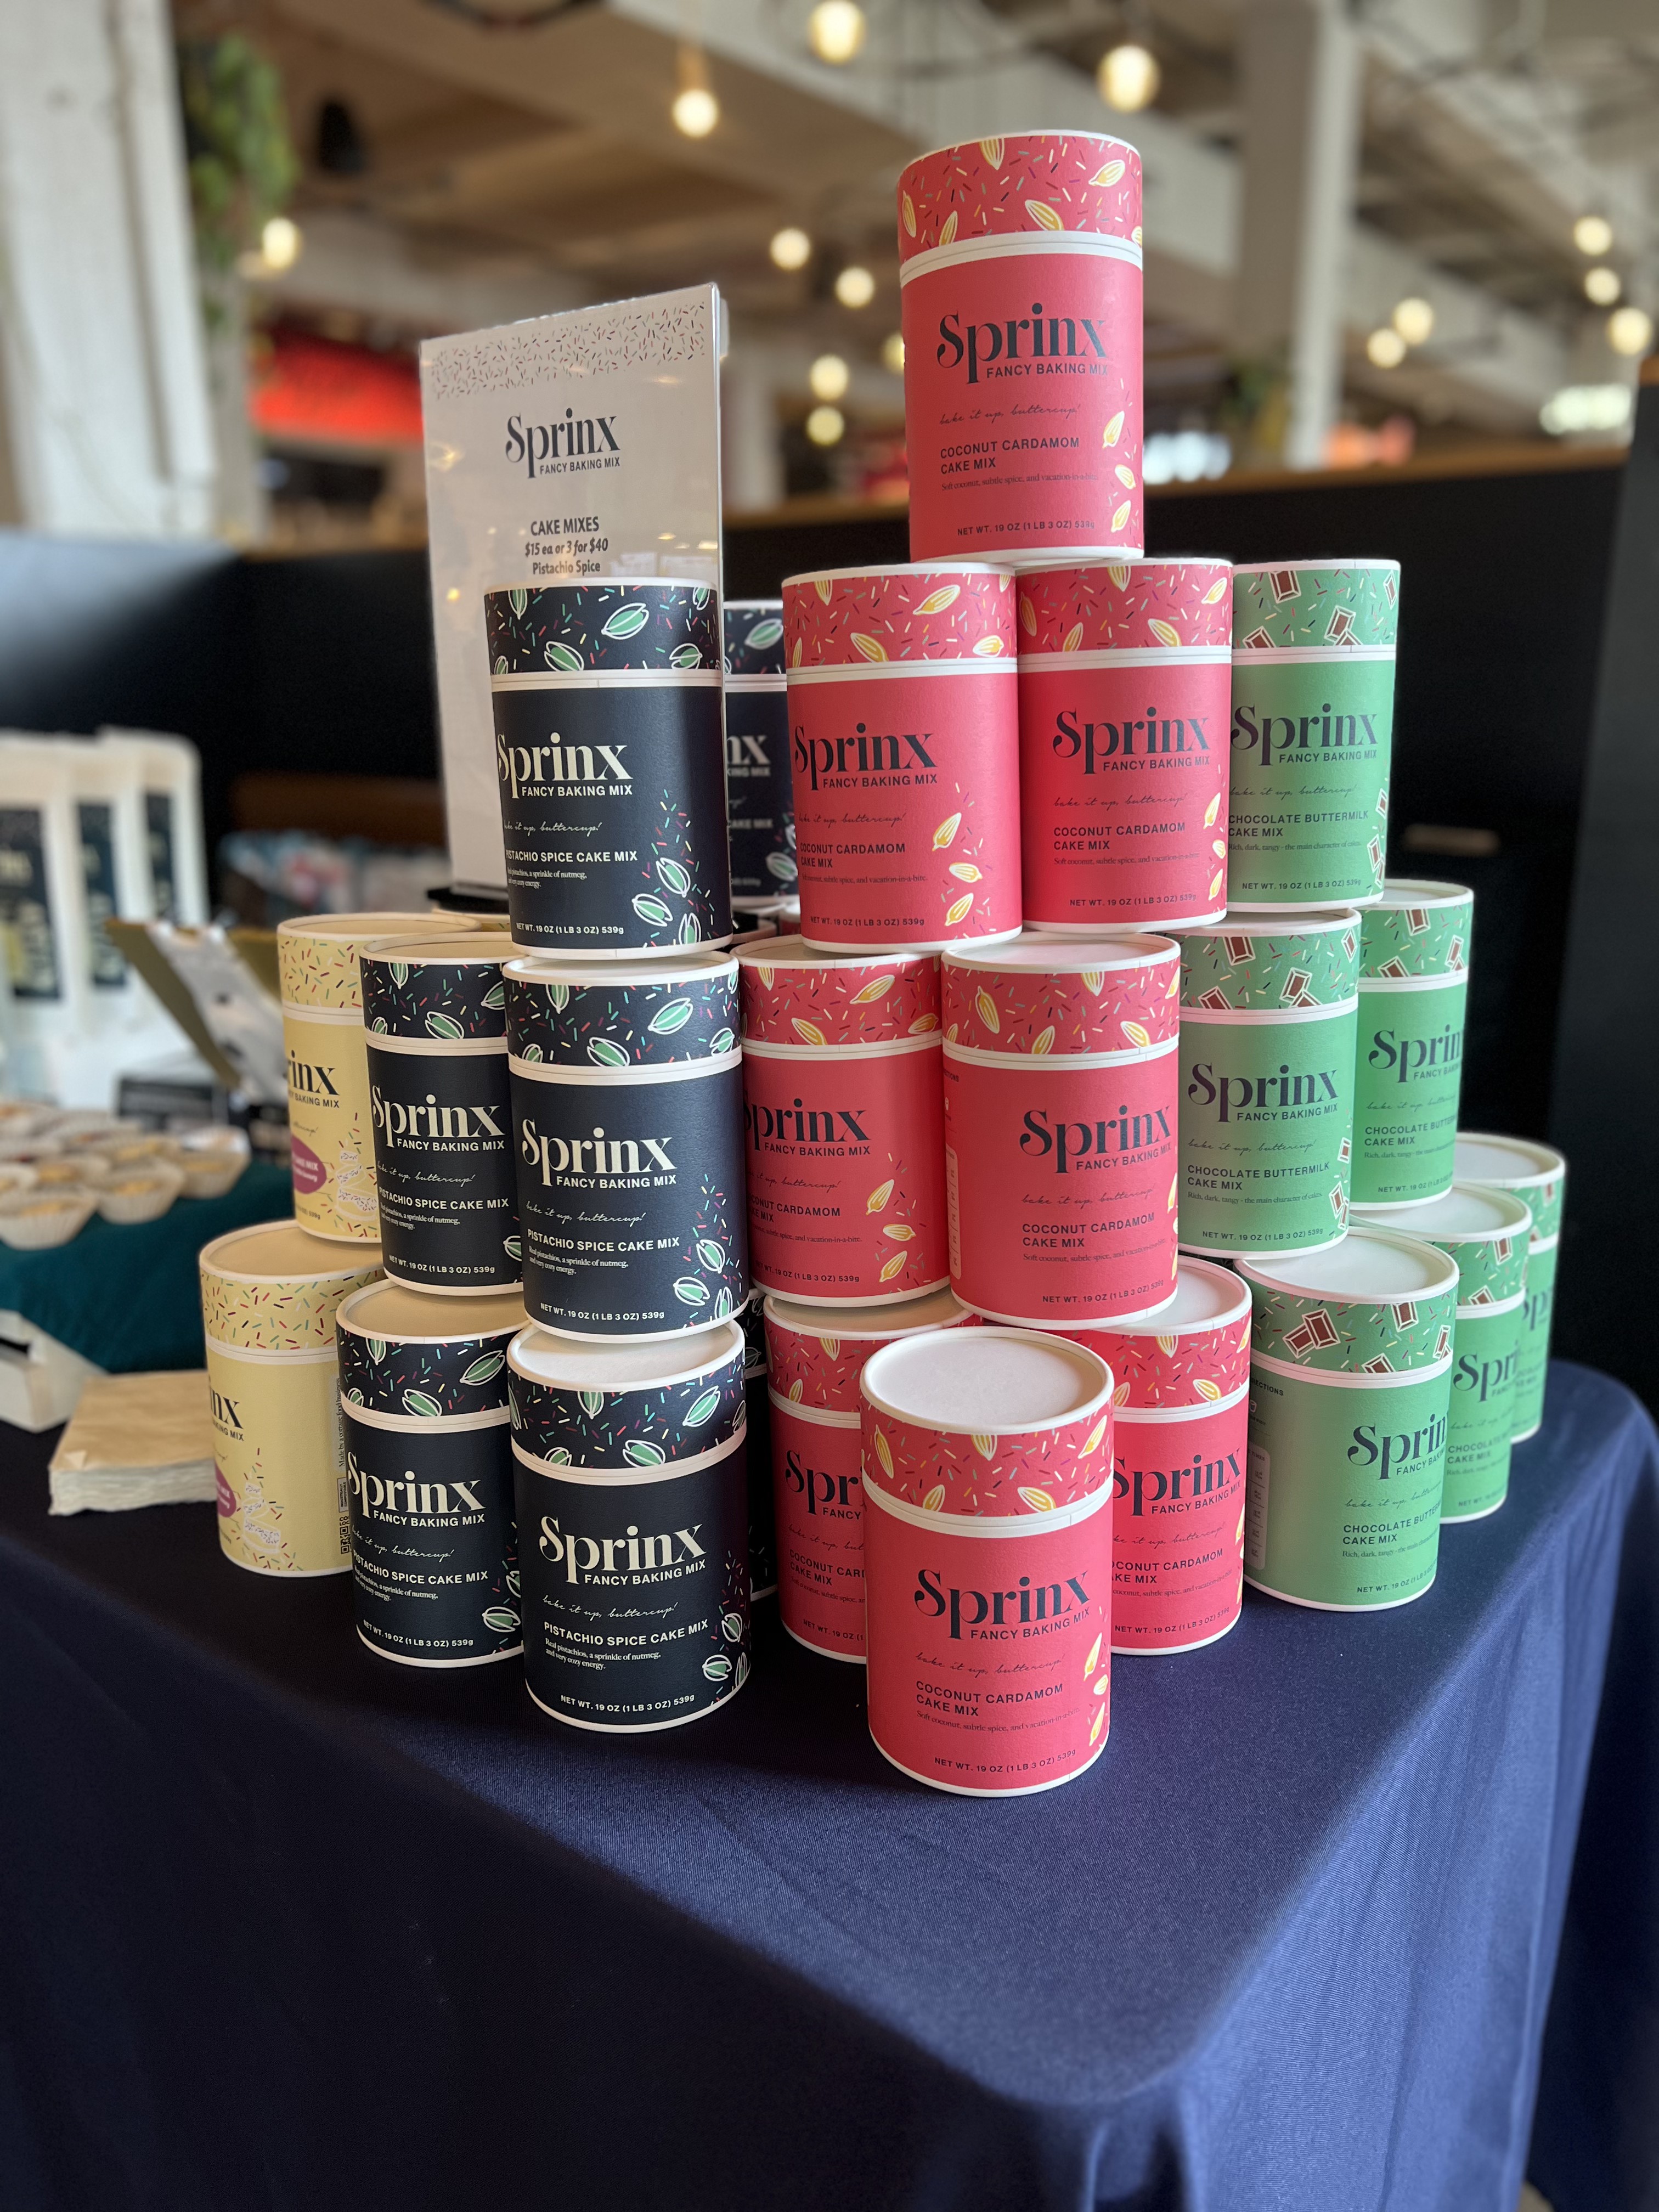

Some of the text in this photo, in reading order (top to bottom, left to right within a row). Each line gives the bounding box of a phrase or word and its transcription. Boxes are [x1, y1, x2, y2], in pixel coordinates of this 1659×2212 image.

[936, 303, 1108, 384] Sprinx
[986, 363, 1108, 378] FANCY BAKING MIX
[505, 408, 620, 479] Sprinx
[940, 438, 1079, 458] COCONUT CARDAMOM
[540, 456, 620, 475] FANCY BAKING MIX
[941, 458, 996, 474] CAKE MIX
[531, 516, 599, 536] CAKE MIXES
[525, 538, 608, 556] $15 ea or 3 for $40
[533, 561, 600, 575] Pistachio Spice
[1053, 707, 1210, 775] Sprinx
[1231, 703, 1378, 766] Sprinx
[497, 732, 634, 799] Sprinx
[795, 723, 938, 791] Sprinx
[1103, 757, 1210, 771] FANCY BAKING MIX
[1279, 750, 1376, 763] FANCY BAKING MIX
[823, 774, 937, 788] FANCY BAKING MIX
[522, 785, 633, 797] FANCY BAKING MIX
[1229, 811, 1368, 824] CHOCOLATE BUTTERMILK
[1054, 823, 1185, 836] COCONUT CARDAMOM
[1228, 828, 1258, 837] CAKE
[1054, 841, 1110, 850] CAKE MIX
[541, 853, 573, 862] SPICE
[577, 853, 611, 862] CAKE
[614, 851, 637, 862] MIX
[1368, 1024, 1460, 1083] Sprin
[1414, 1069, 1442, 1080] FANCY
[295, 1094, 339, 1108] BAKING MIX
[1188, 1063, 1338, 1122] Sprinx
[372, 1085, 506, 1148] Sprinx
[1237, 1103, 1338, 1121] FANCY BAKING MIX
[1019, 1105, 1171, 1173] Sprinx
[1365, 1124, 1428, 1135] CHOCOLATE
[397, 1139, 505, 1151] FANCY BAKING MIX
[1365, 1138, 1394, 1146] CAKE
[522, 1119, 678, 1187] Sprinx
[1076, 1143, 1171, 1170] FANCY BAKING MIX
[1188, 1162, 1329, 1178] CHOCOLATE BUTTERMILK
[557, 1175, 677, 1188] FANCY BAKING MIX
[1188, 1178, 1243, 1190] CAKE MIX
[379, 1187, 510, 1210] PISTACHIO SPICE CAKE MIX
[1023, 1212, 1154, 1234] COCONUT CARDAMOM
[528, 1229, 680, 1251] PISTACHIO SPICE CAKE MIX
[1347, 1413, 1448, 1480] Sprin
[1396, 1460, 1426, 1475] FANCY
[348, 1452, 486, 1519] Sprinx
[1114, 1448, 1240, 1516] Sprinx
[1152, 1481, 1240, 1514] FANCY BAKING MIX
[374, 1510, 485, 1527] FANCY BAKING MIX
[1344, 1520, 1411, 1533] CHOCOLATE
[1379, 1534, 1397, 1544] MIX
[539, 1516, 707, 1585] Sprinx
[353, 1550, 488, 1584] PISTACHIO SPICE CAKE MIX
[585, 1559, 706, 1585] FANCY BAKING MIX
[543, 1595, 678, 1621] bake it up, buttercup!
[914, 1569, 1090, 1640] Sprinx
[970, 1607, 1090, 1639] FANCY BAKING MIX
[544, 1620, 708, 1646] PISTACHIO SPICE CAKE MIX
[582, 1661, 606, 1671] energy.
[595, 1652, 622, 1661] sprinkle
[916, 1681, 1063, 1703] COCONUT CARDAMOM
[561, 1695, 575, 1705] NET
[623, 1705, 630, 1713] (1
[655, 1701, 671, 1709] OZ)
[674, 1695, 695, 1705] 539g
[916, 1695, 979, 1716] CAKE MIX
